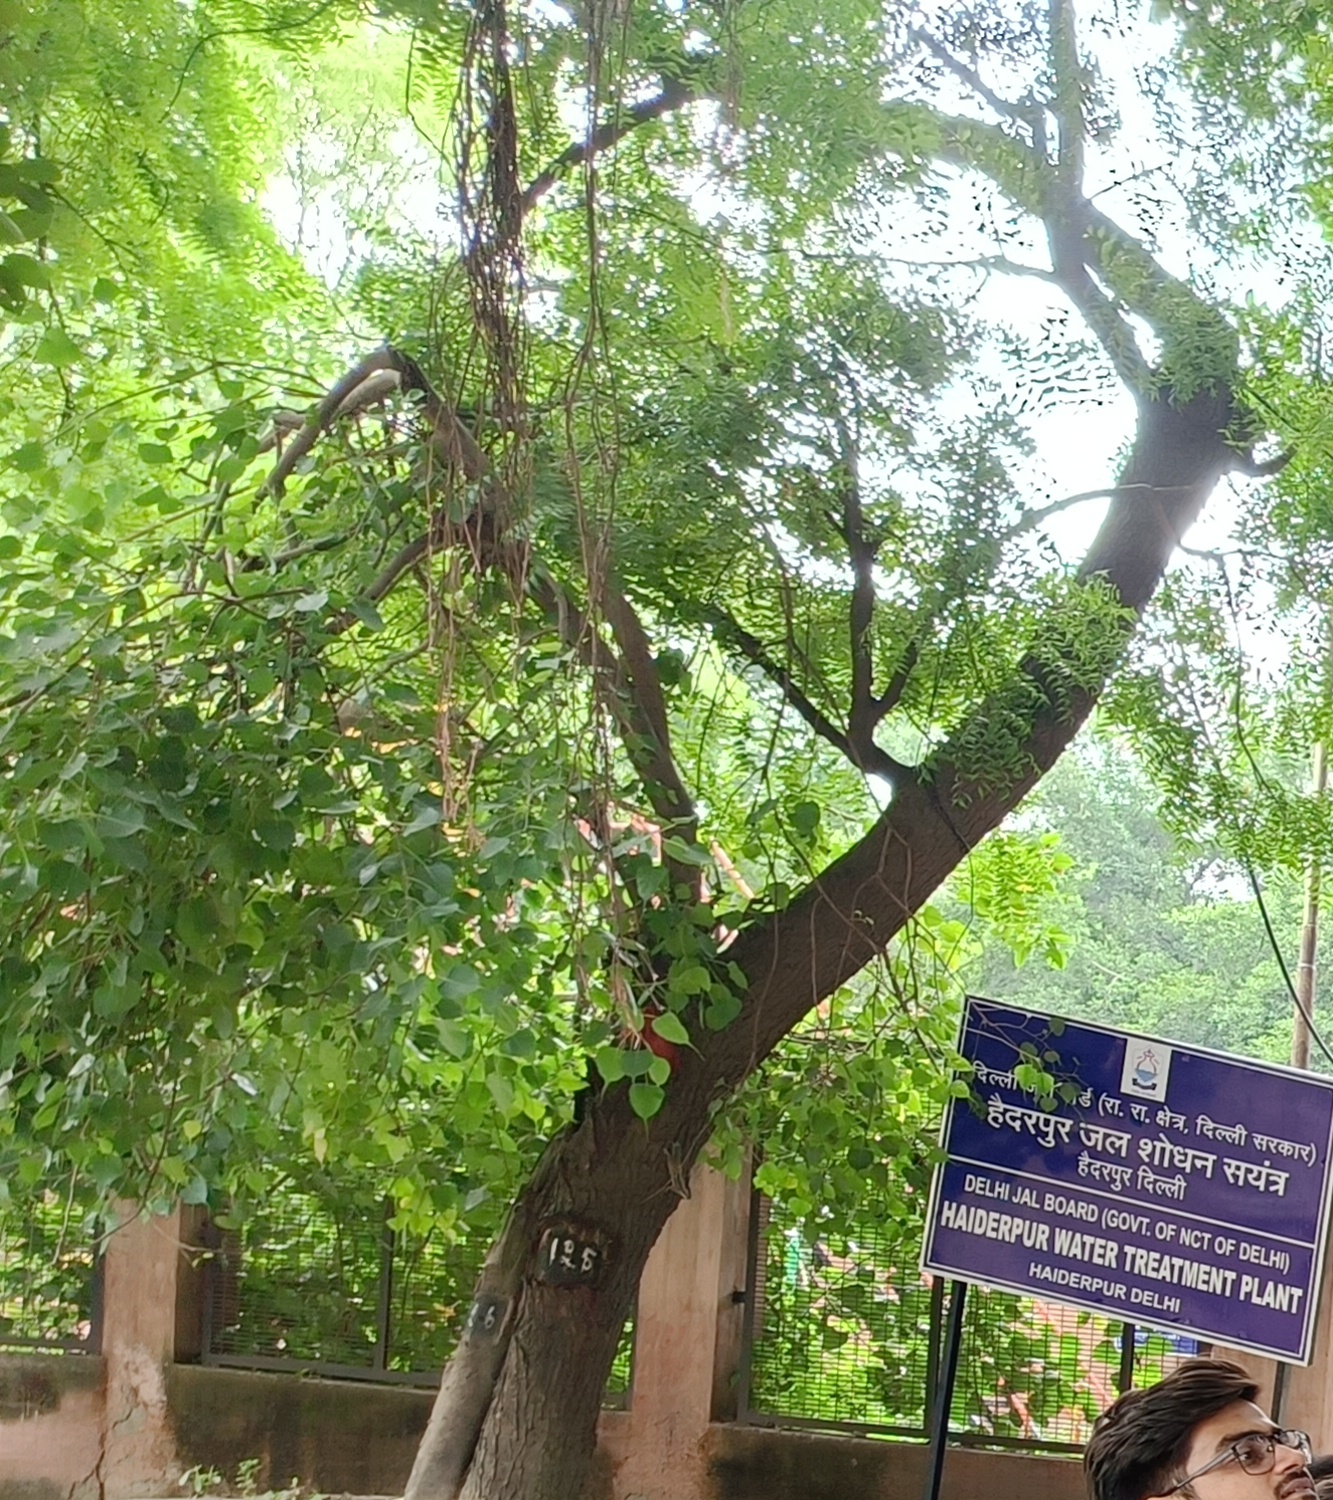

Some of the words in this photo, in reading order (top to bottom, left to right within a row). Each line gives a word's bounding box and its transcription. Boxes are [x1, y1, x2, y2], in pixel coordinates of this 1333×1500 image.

[987, 1092, 1073, 1148] हैदरपुर
[1079, 1122, 1131, 1157] जल
[1138, 1133, 1217, 1179] शोधन
[1223, 1160, 1290, 1197] सयंत्र
[1098, 1092, 1124, 1117] (रा.
[1130, 1103, 1150, 1123] रा.
[1156, 1106, 1189, 1134] क्षेत्र,
[1196, 1115, 1247, 1146] दिल्ली
[1252, 1133, 1316, 1167] सरकार)
[1077, 1151, 1133, 1192] हैदरपुर
[1137, 1165, 1187, 1200] दिल्ली
[940, 1200, 1050, 1251] HAIDERPUR
[1054, 1227, 1119, 1269] WATER
[1124, 1245, 1237, 1297] TREATMENT
[1239, 1274, 1303, 1314] PLANT
[964, 1174, 1010, 1201] DELHI
[1012, 1187, 1041, 1209] JAL
[1043, 1193, 1098, 1222] BOARD
[1101, 1207, 1151, 1237] (GOVT.
[1155, 1221, 1177, 1243] OF
[1179, 1227, 1212, 1251] NCT
[1214, 1236, 1236, 1257] OF
[1239, 1242, 1290, 1275] DELHI)
[1028, 1262, 1127, 1300] HAIDERPUR
[1130, 1287, 1181, 1314] DELHI
